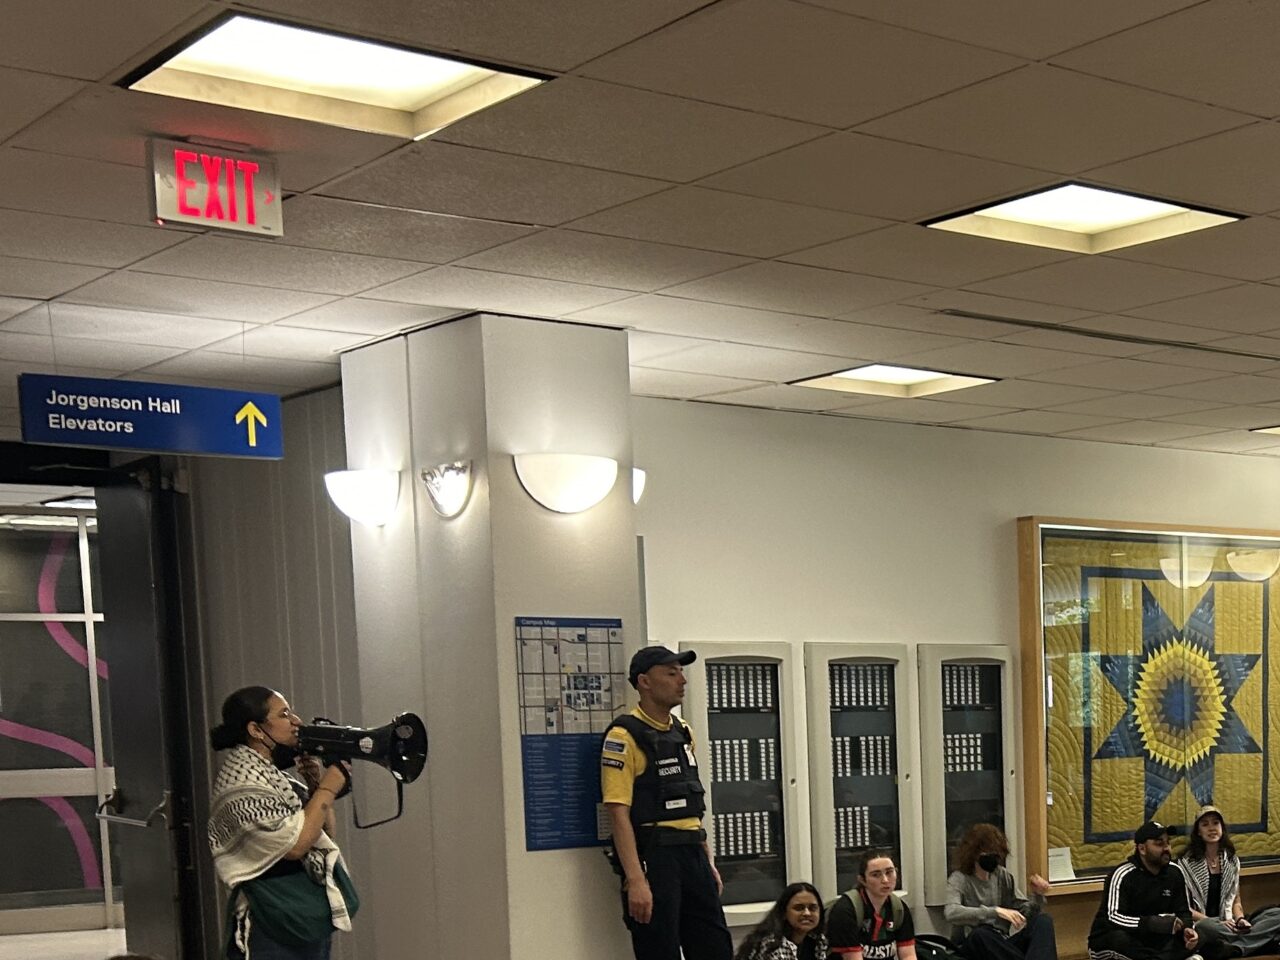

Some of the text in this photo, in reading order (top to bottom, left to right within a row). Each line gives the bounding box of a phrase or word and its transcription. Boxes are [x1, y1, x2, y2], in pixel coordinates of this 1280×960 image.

[174, 149, 260, 225] EXIT
[46, 389, 181, 415] Jorgenson Hall
[48, 413, 134, 434] Elevators
[521, 619, 543, 627] Campus
